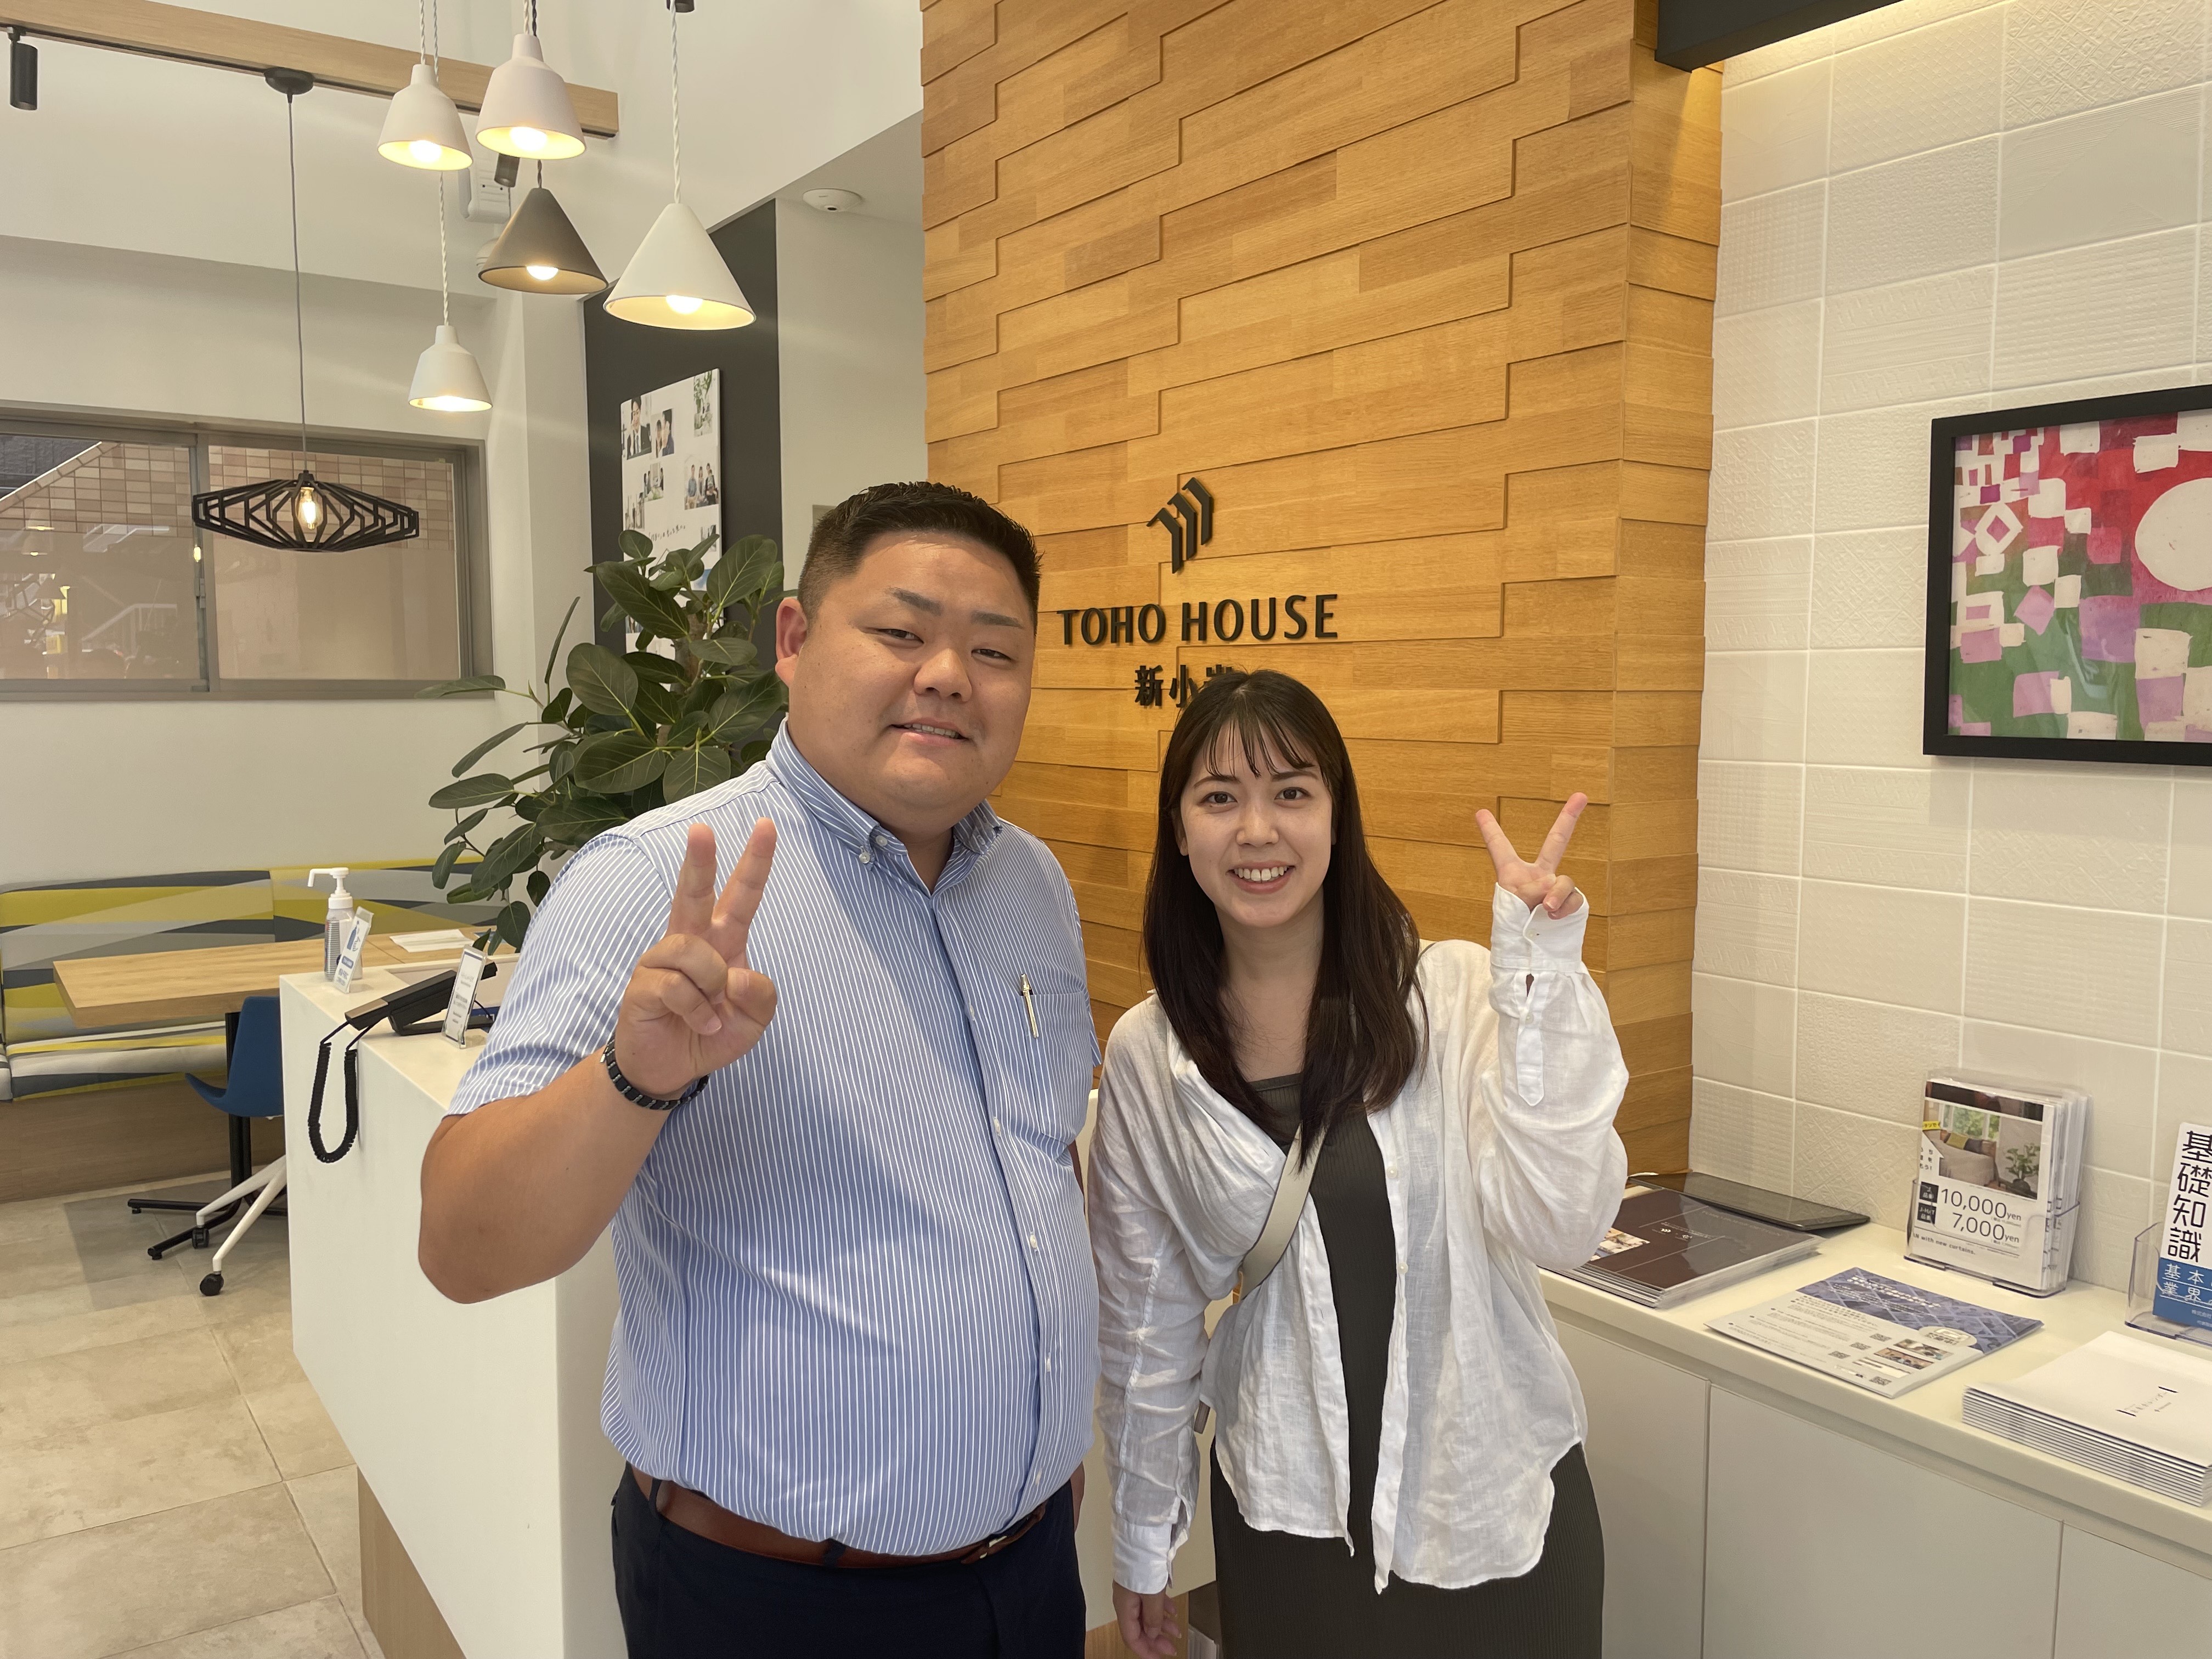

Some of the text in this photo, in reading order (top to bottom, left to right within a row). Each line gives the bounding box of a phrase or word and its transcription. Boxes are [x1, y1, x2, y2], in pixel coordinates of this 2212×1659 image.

[1057, 594, 1338, 645] TOHO HOUSE
[2168, 1131, 2212, 1262] 基礎知識
[1949, 1242, 1976, 1255] curtains.
[2164, 1263, 2212, 1287] 基本
